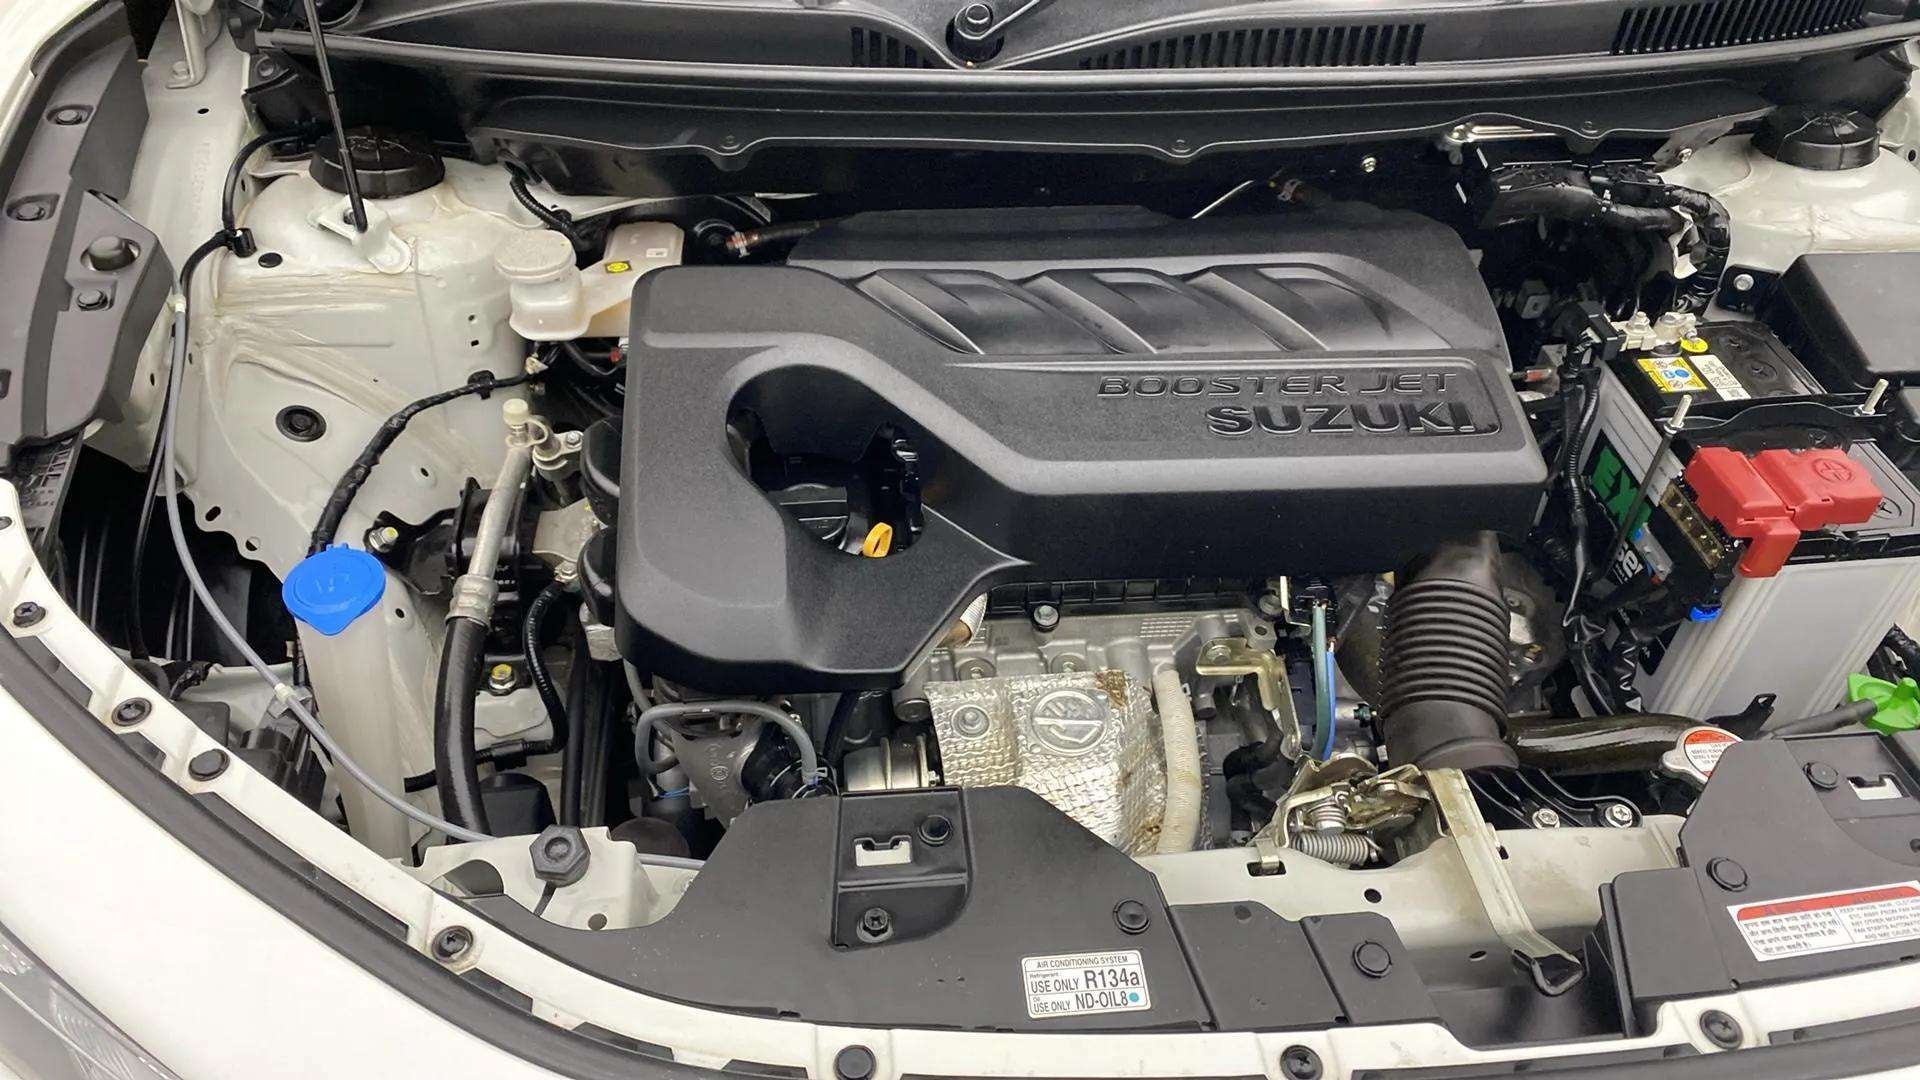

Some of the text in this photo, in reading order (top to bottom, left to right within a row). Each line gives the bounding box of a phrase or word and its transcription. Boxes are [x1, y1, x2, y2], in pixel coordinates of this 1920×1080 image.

[1097, 373, 1457, 397] BOOSTER JET
[1205, 401, 1476, 436] SUZUKI
[1050, 958, 1099, 967] CONDITIONING
[1101, 956, 1128, 964] SYSTEM
[1031, 968, 1140, 993] USE ONLY R134a
[1034, 991, 1128, 1013] USE ONLY ND-OIL8
